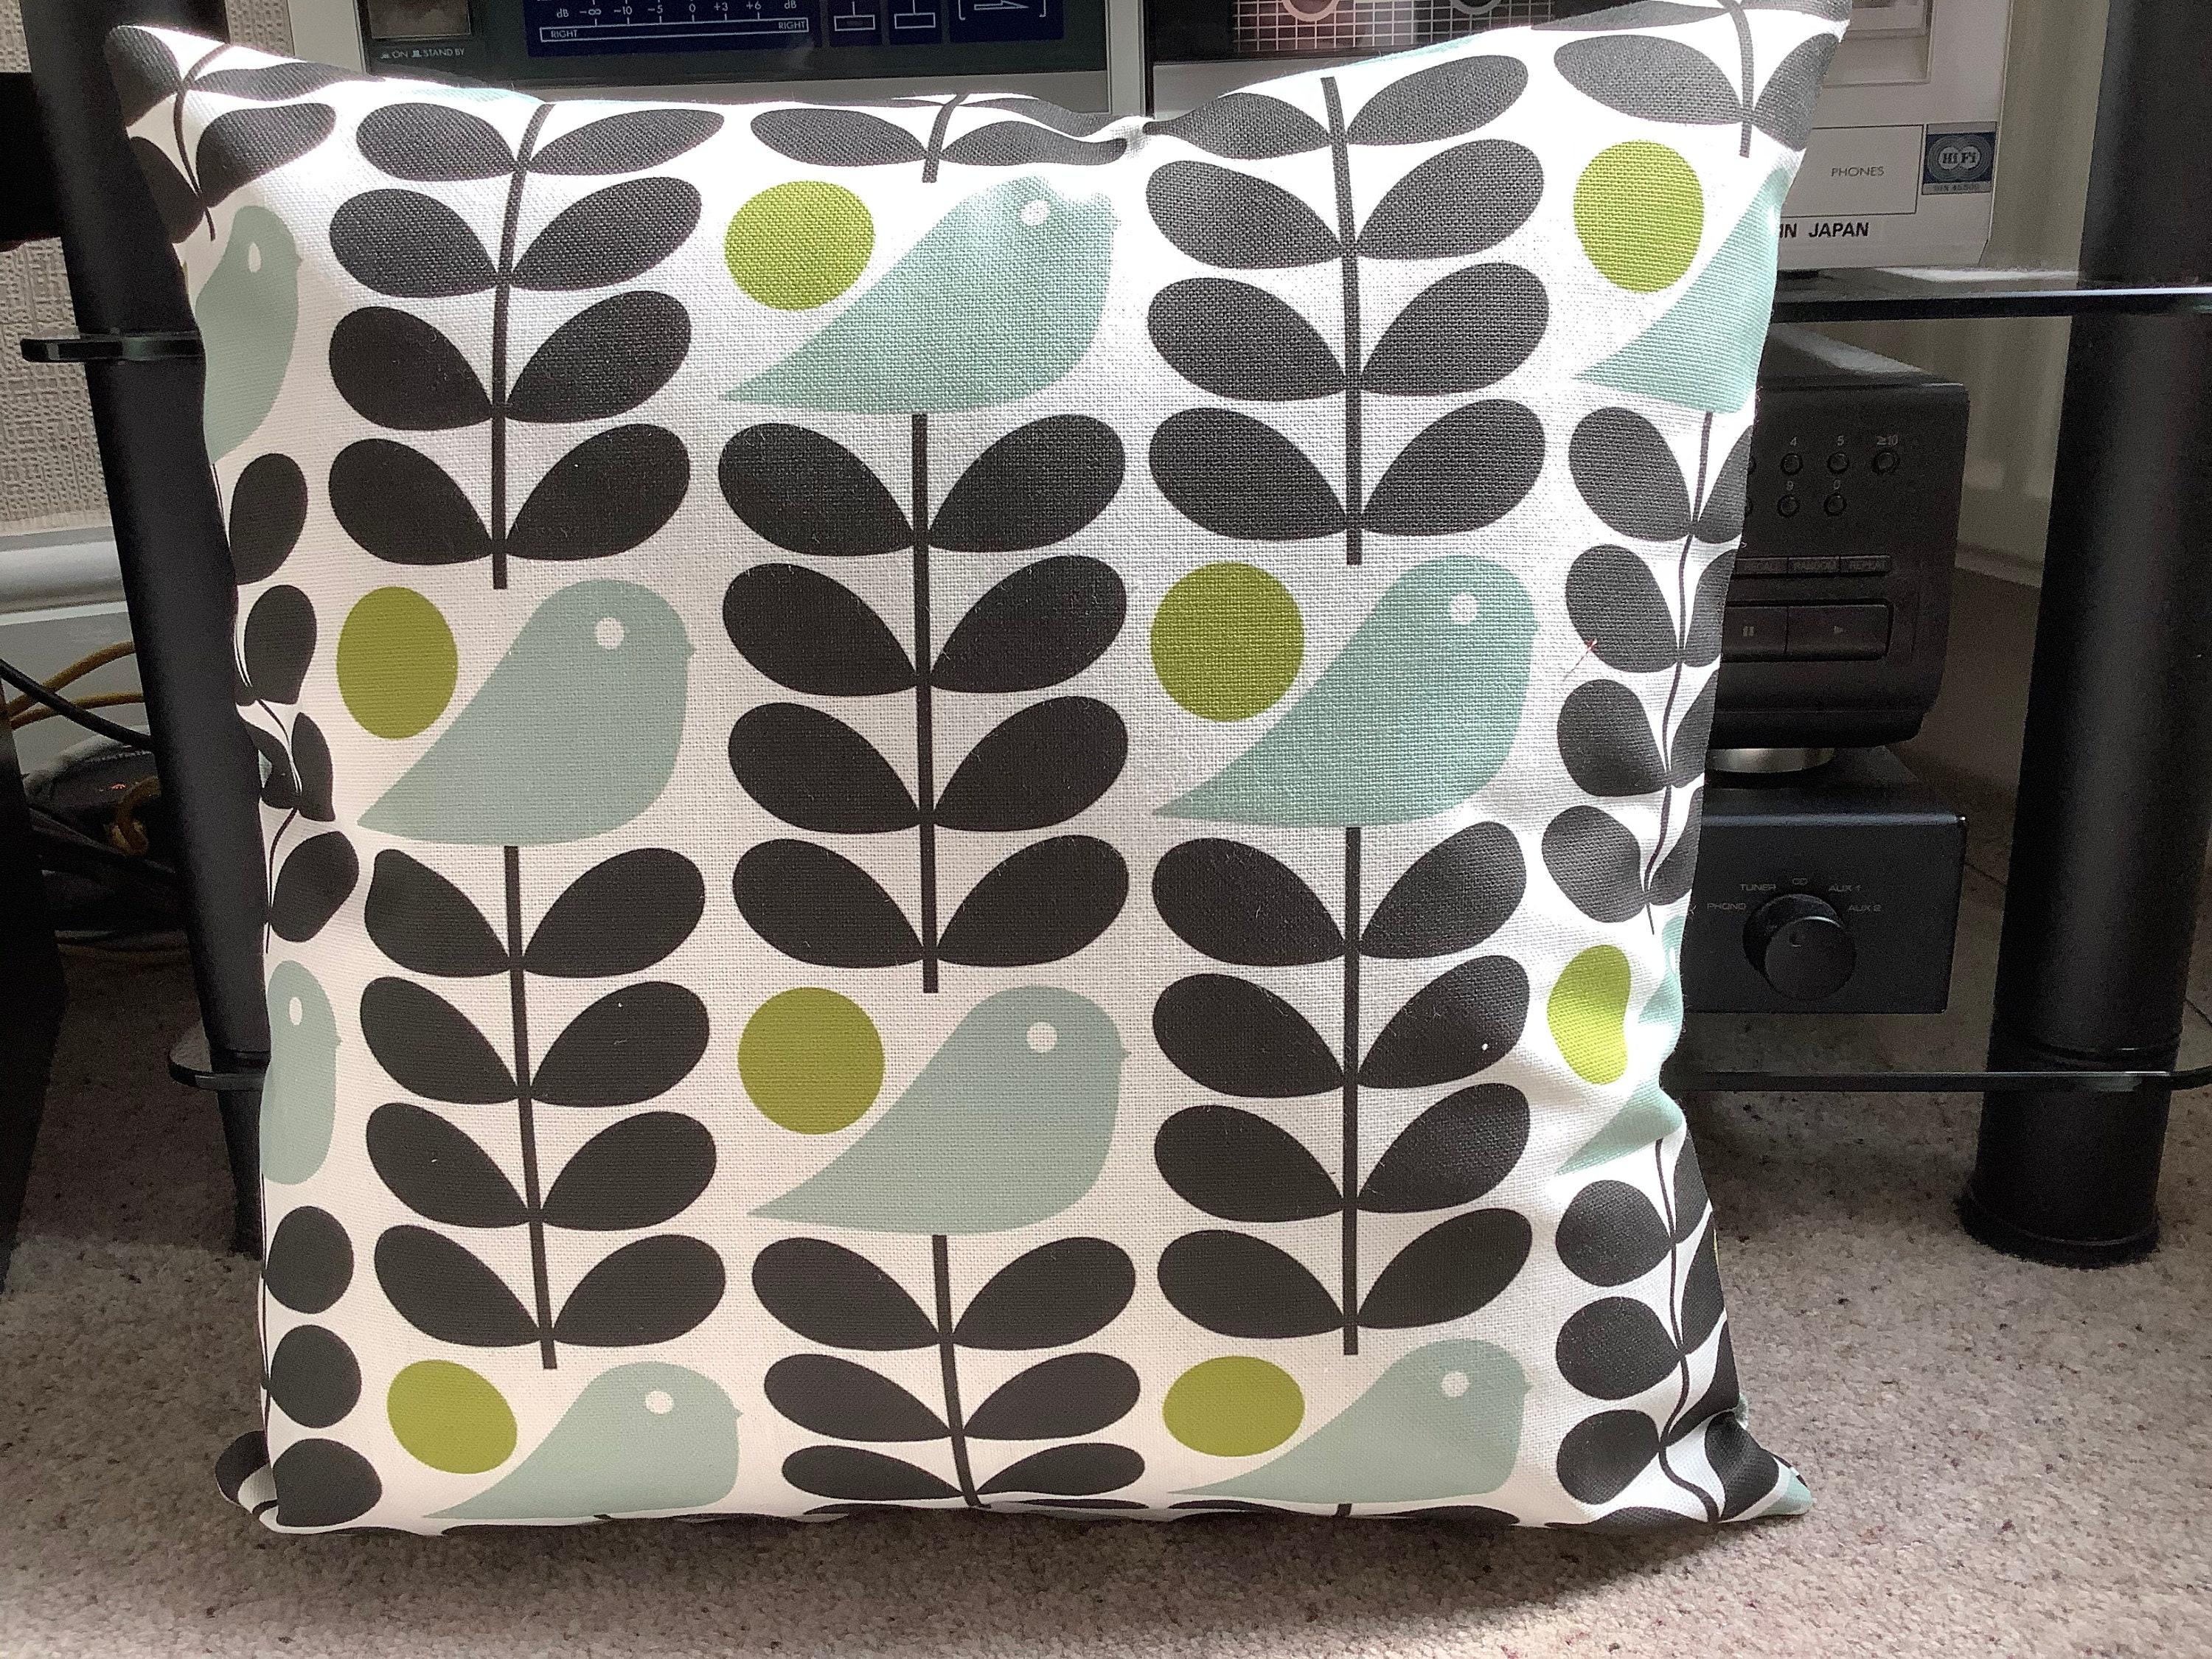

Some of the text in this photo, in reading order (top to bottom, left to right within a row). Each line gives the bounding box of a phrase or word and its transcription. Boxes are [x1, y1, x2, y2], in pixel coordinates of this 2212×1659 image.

[556, 8, 569, 18] dB
[613, 6, 633, 15] -10
[647, 5, 663, 14] -5
[689, 3, 696, 13] 0
[713, 2, 728, 12] +3
[745, 1, 762, 10] +6
[784, 0, 797, 10] dB
[778, 21, 805, 29] RIGHT
[551, 29, 578, 38] RIGHT
[392, 49, 408, 58] ON
[1831, 166, 1885, 178] PHONES
[1808, 222, 1869, 237] JAPAN
[1790, 437, 1798, 447] 4
[1836, 435, 1845, 447] 5
[1793, 560, 1837, 571] RANDOM
[1849, 560, 1887, 570] REPEAT
[1791, 877, 1808, 886] CD
[1739, 883, 1777, 891] TUNER
[1828, 884, 1852, 892] AUX
[1706, 902, 1746, 911] PHONO
